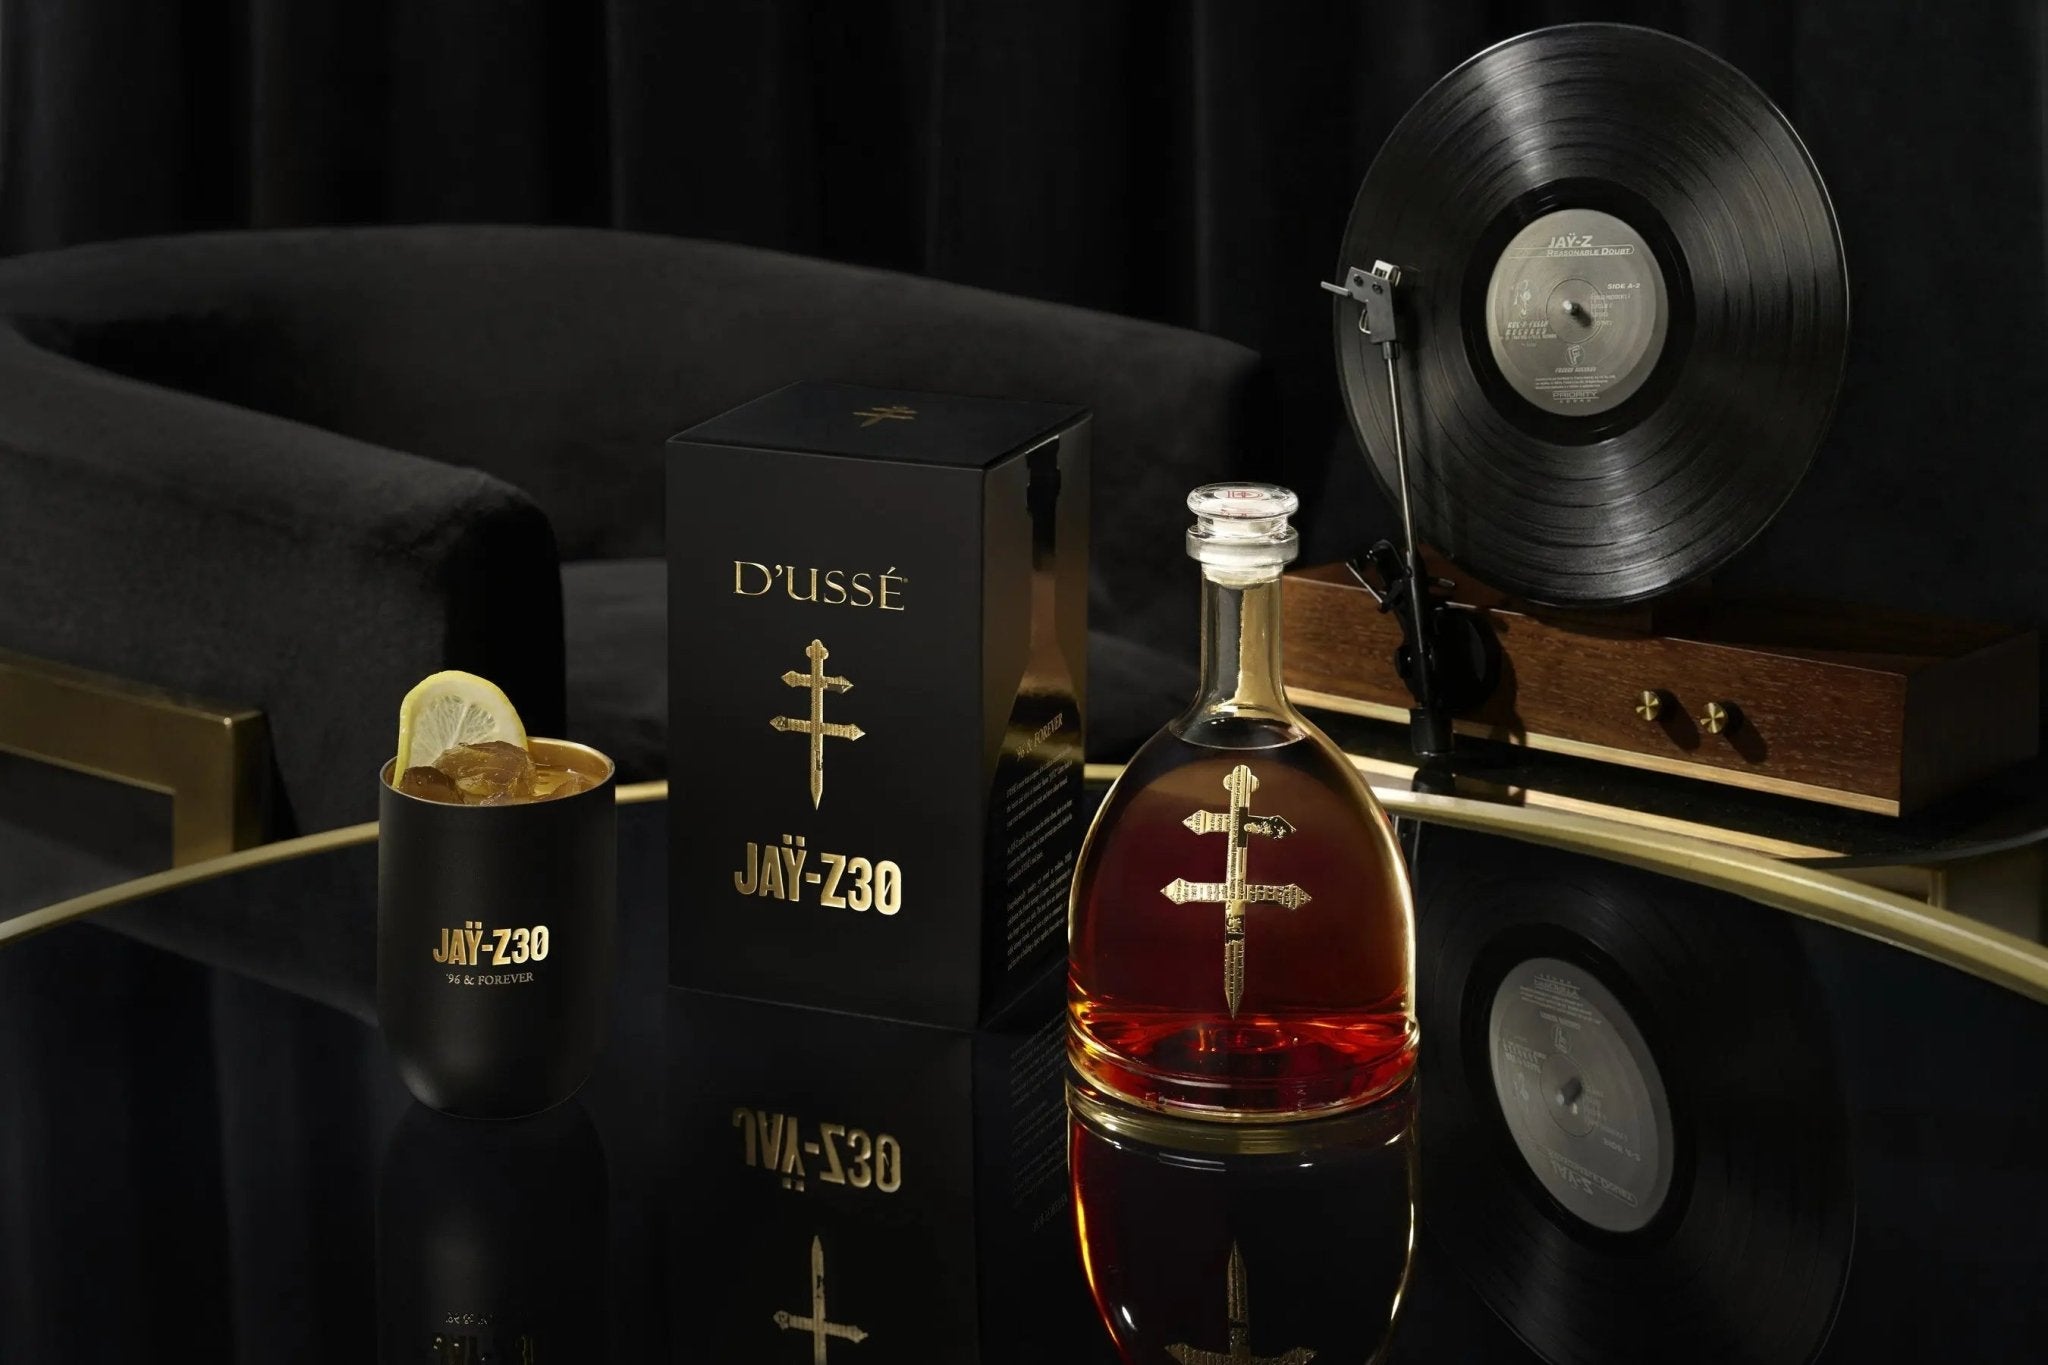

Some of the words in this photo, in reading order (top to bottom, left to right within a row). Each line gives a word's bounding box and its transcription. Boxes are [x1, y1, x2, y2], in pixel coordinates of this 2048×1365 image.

[1548, 233, 1593, 248] JAŸ-Z
[1546, 249, 1599, 257] REASONABLE
[1601, 247, 1631, 256] DOUBT
[733, 833, 903, 917] JAŸ-Z30
[432, 920, 550, 966] JAŸ-Z30
[464, 974, 474, 986] &
[478, 972, 535, 985] FOREVER
